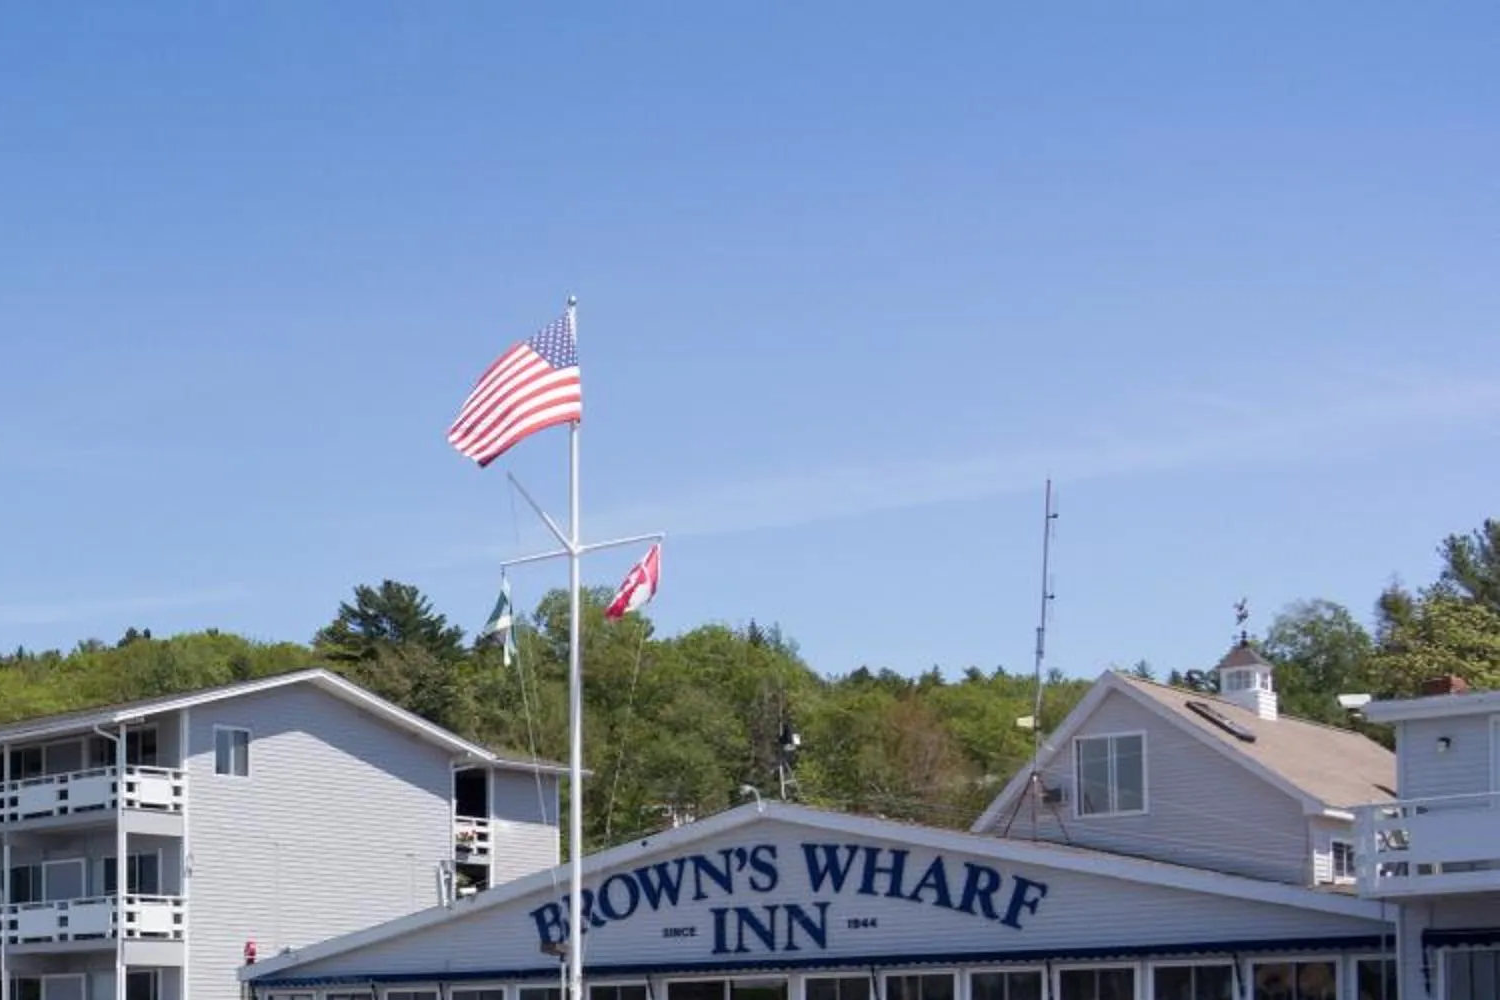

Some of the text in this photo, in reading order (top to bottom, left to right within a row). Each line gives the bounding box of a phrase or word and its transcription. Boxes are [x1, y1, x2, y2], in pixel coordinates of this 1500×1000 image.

[528, 843, 1048, 944] BROWN'S WHARF
[662, 917, 878, 938] SINCE 1944
[709, 901, 831, 954] INN
